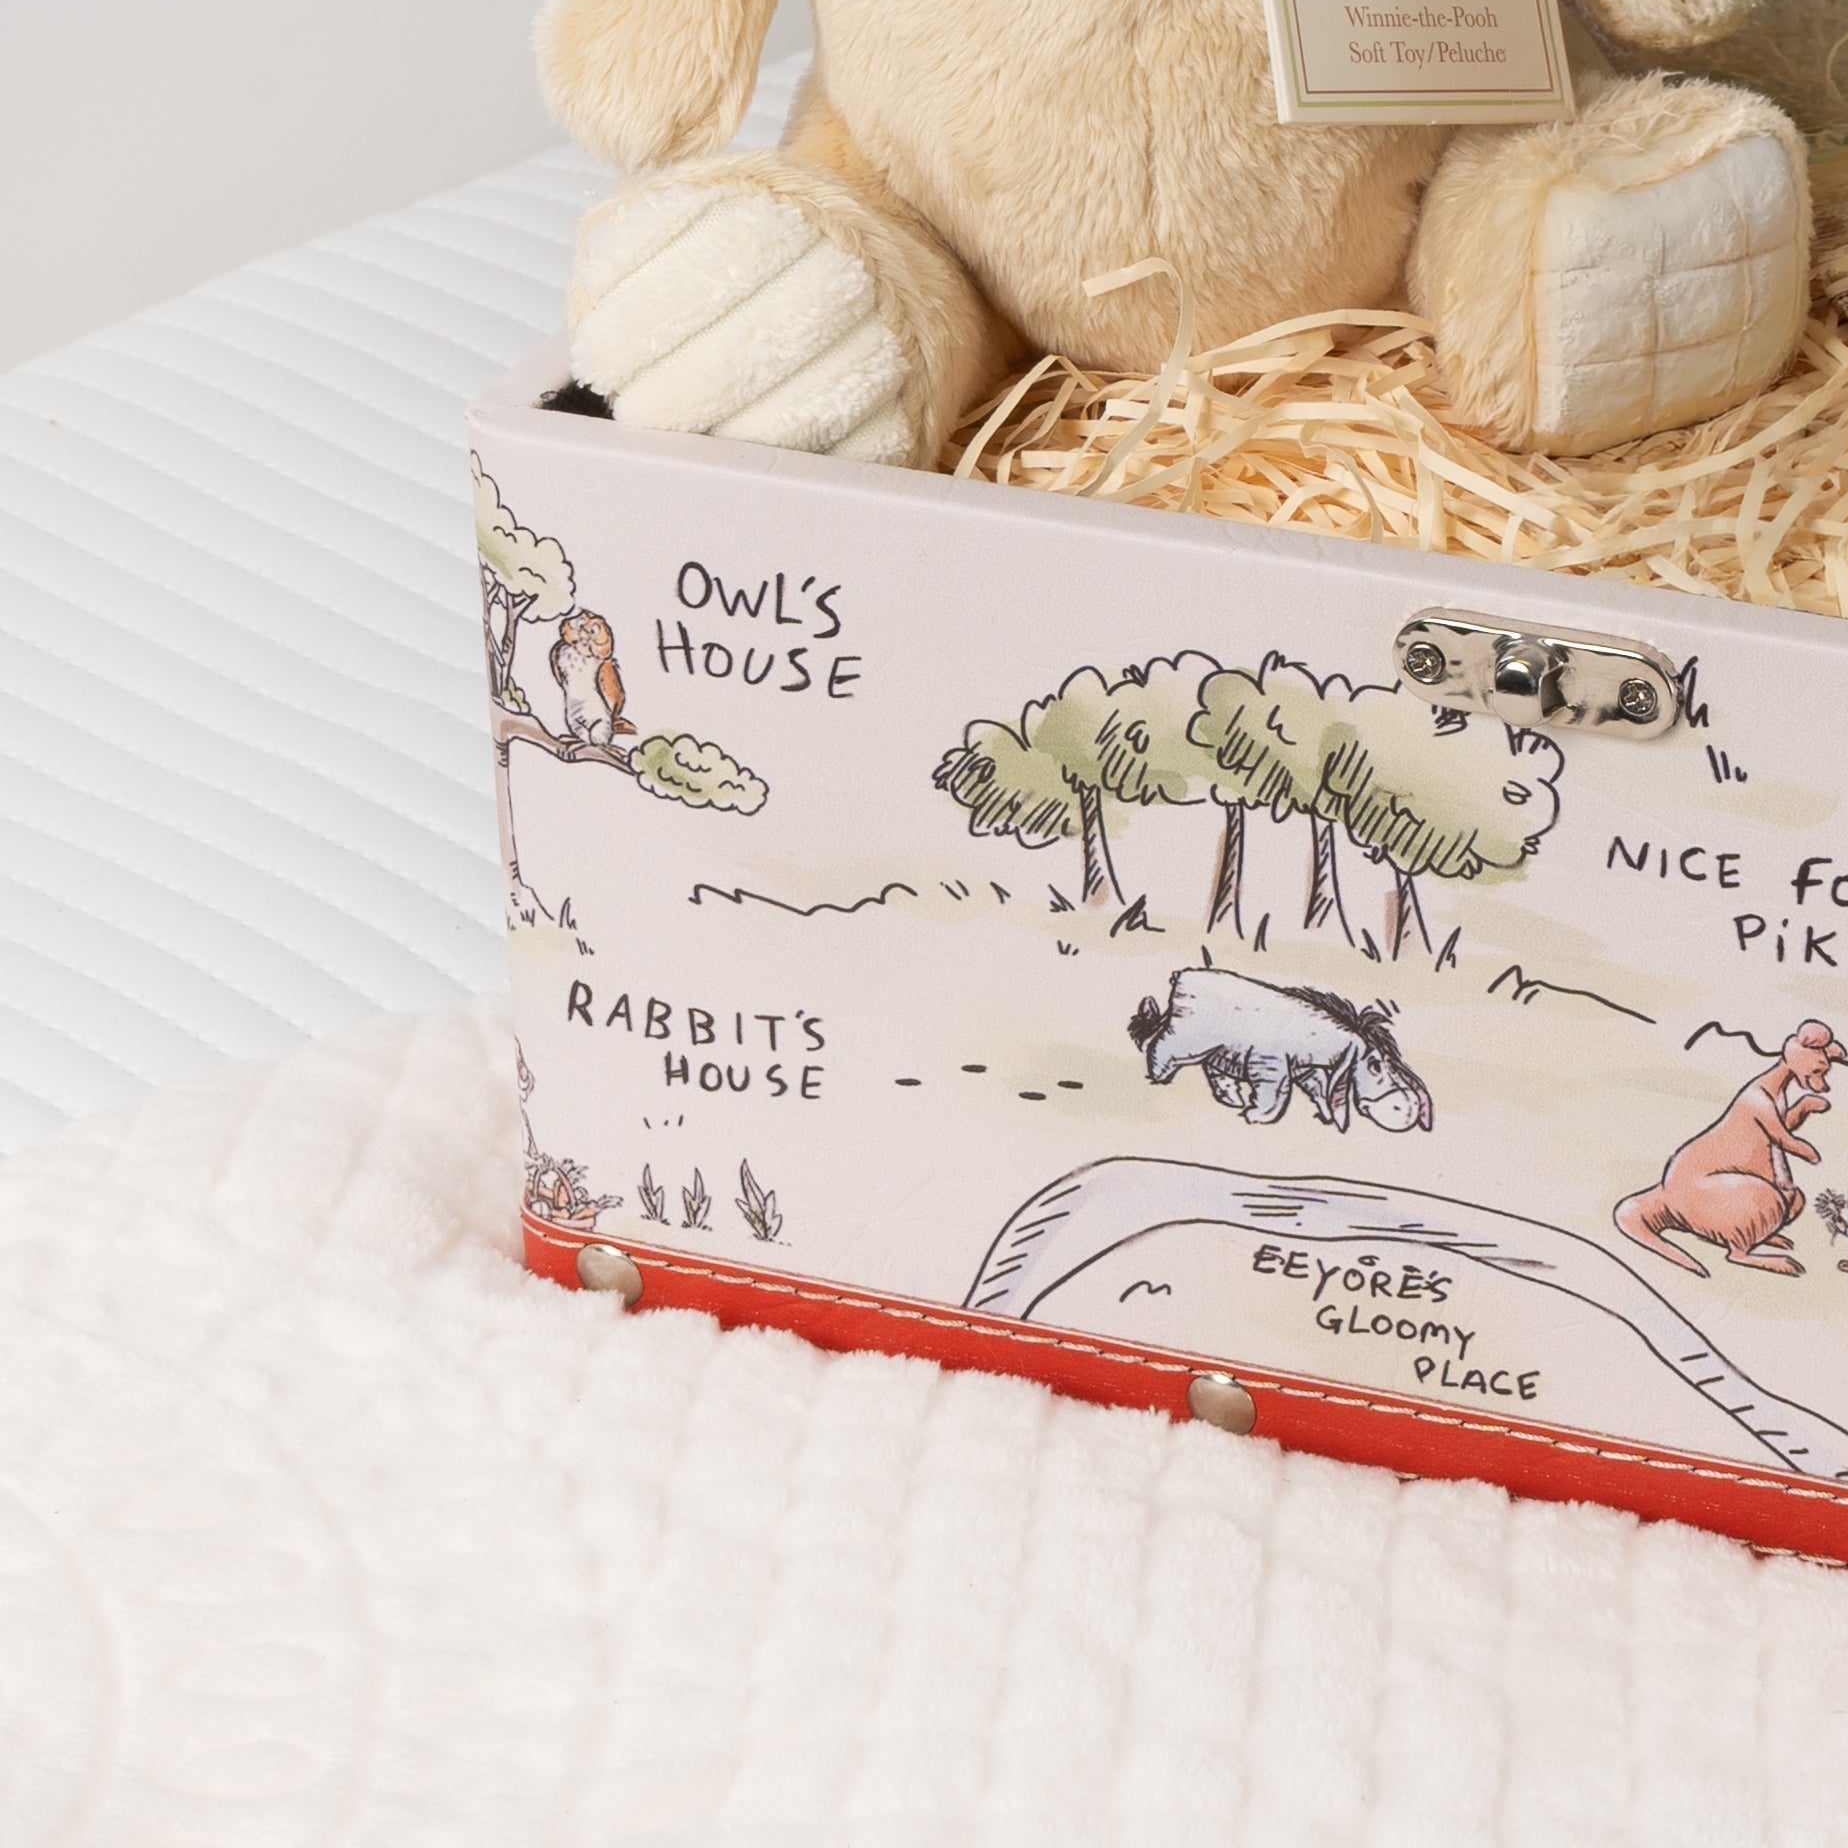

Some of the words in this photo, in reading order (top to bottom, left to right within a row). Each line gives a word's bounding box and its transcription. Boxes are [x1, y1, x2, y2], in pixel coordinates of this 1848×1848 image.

[1344, 5, 1499, 28] Winnie-the-Pooh
[1348, 40, 1388, 64] Soft
[677, 561, 842, 639] OWL'S
[656, 618, 862, 699] HOUSE
[1606, 835, 1741, 889] NICE
[567, 979, 825, 1052] RABBIT'S
[664, 1050, 825, 1100] HOUSE
[1413, 1355, 1541, 1401] PLACE
